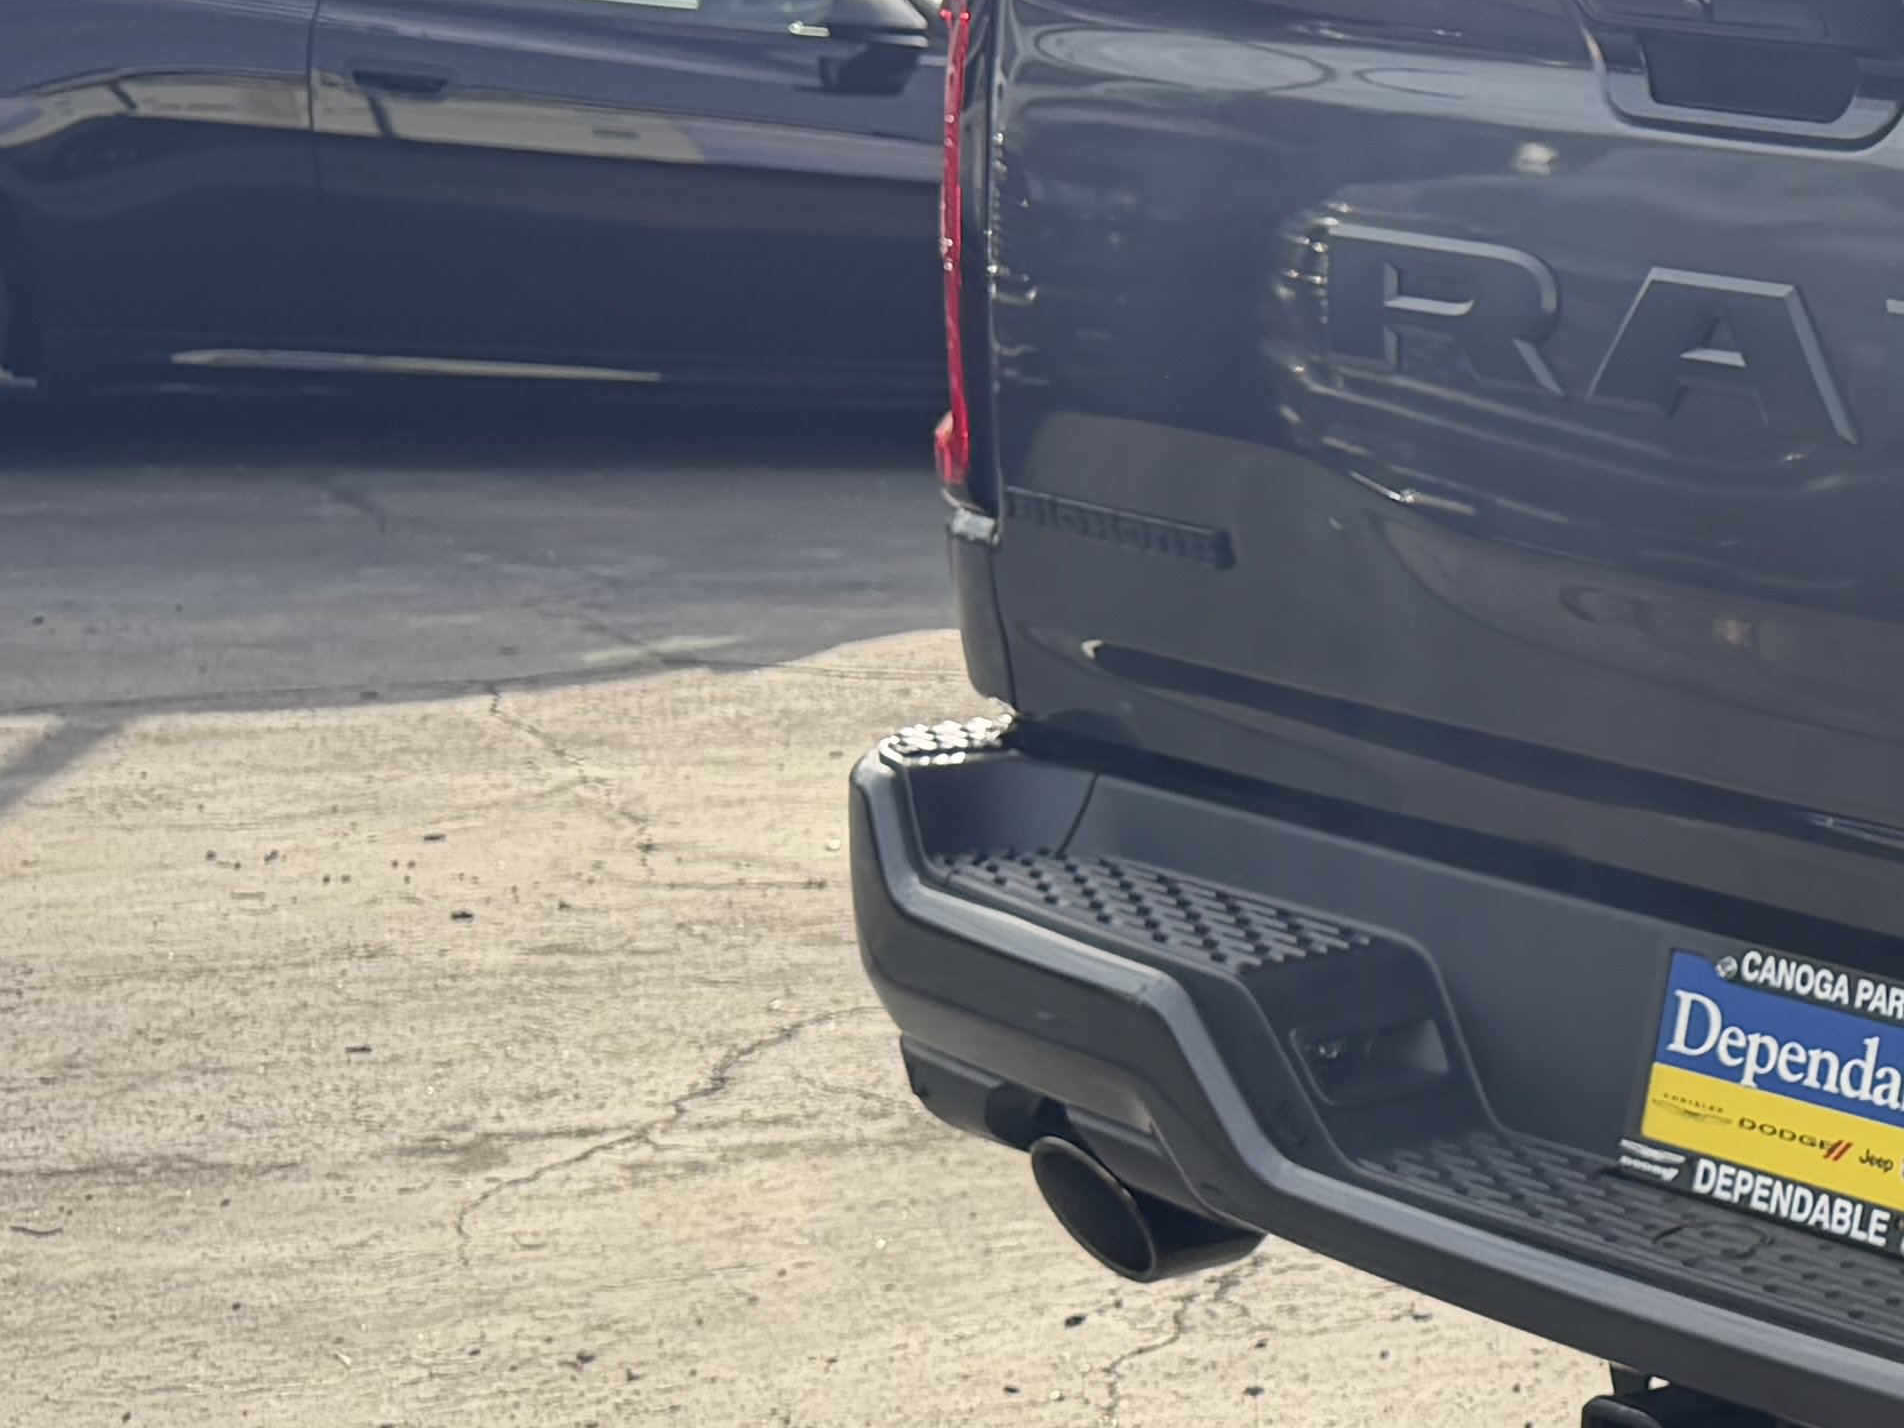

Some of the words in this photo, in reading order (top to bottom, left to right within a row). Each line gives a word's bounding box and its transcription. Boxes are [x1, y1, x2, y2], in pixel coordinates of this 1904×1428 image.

[1740, 950, 1851, 1006] CANOGA
[1738, 1115, 1832, 1151] DODGE
[1859, 1148, 1894, 1174] Jeep
[1692, 1158, 1890, 1247] DEPENDABLE
